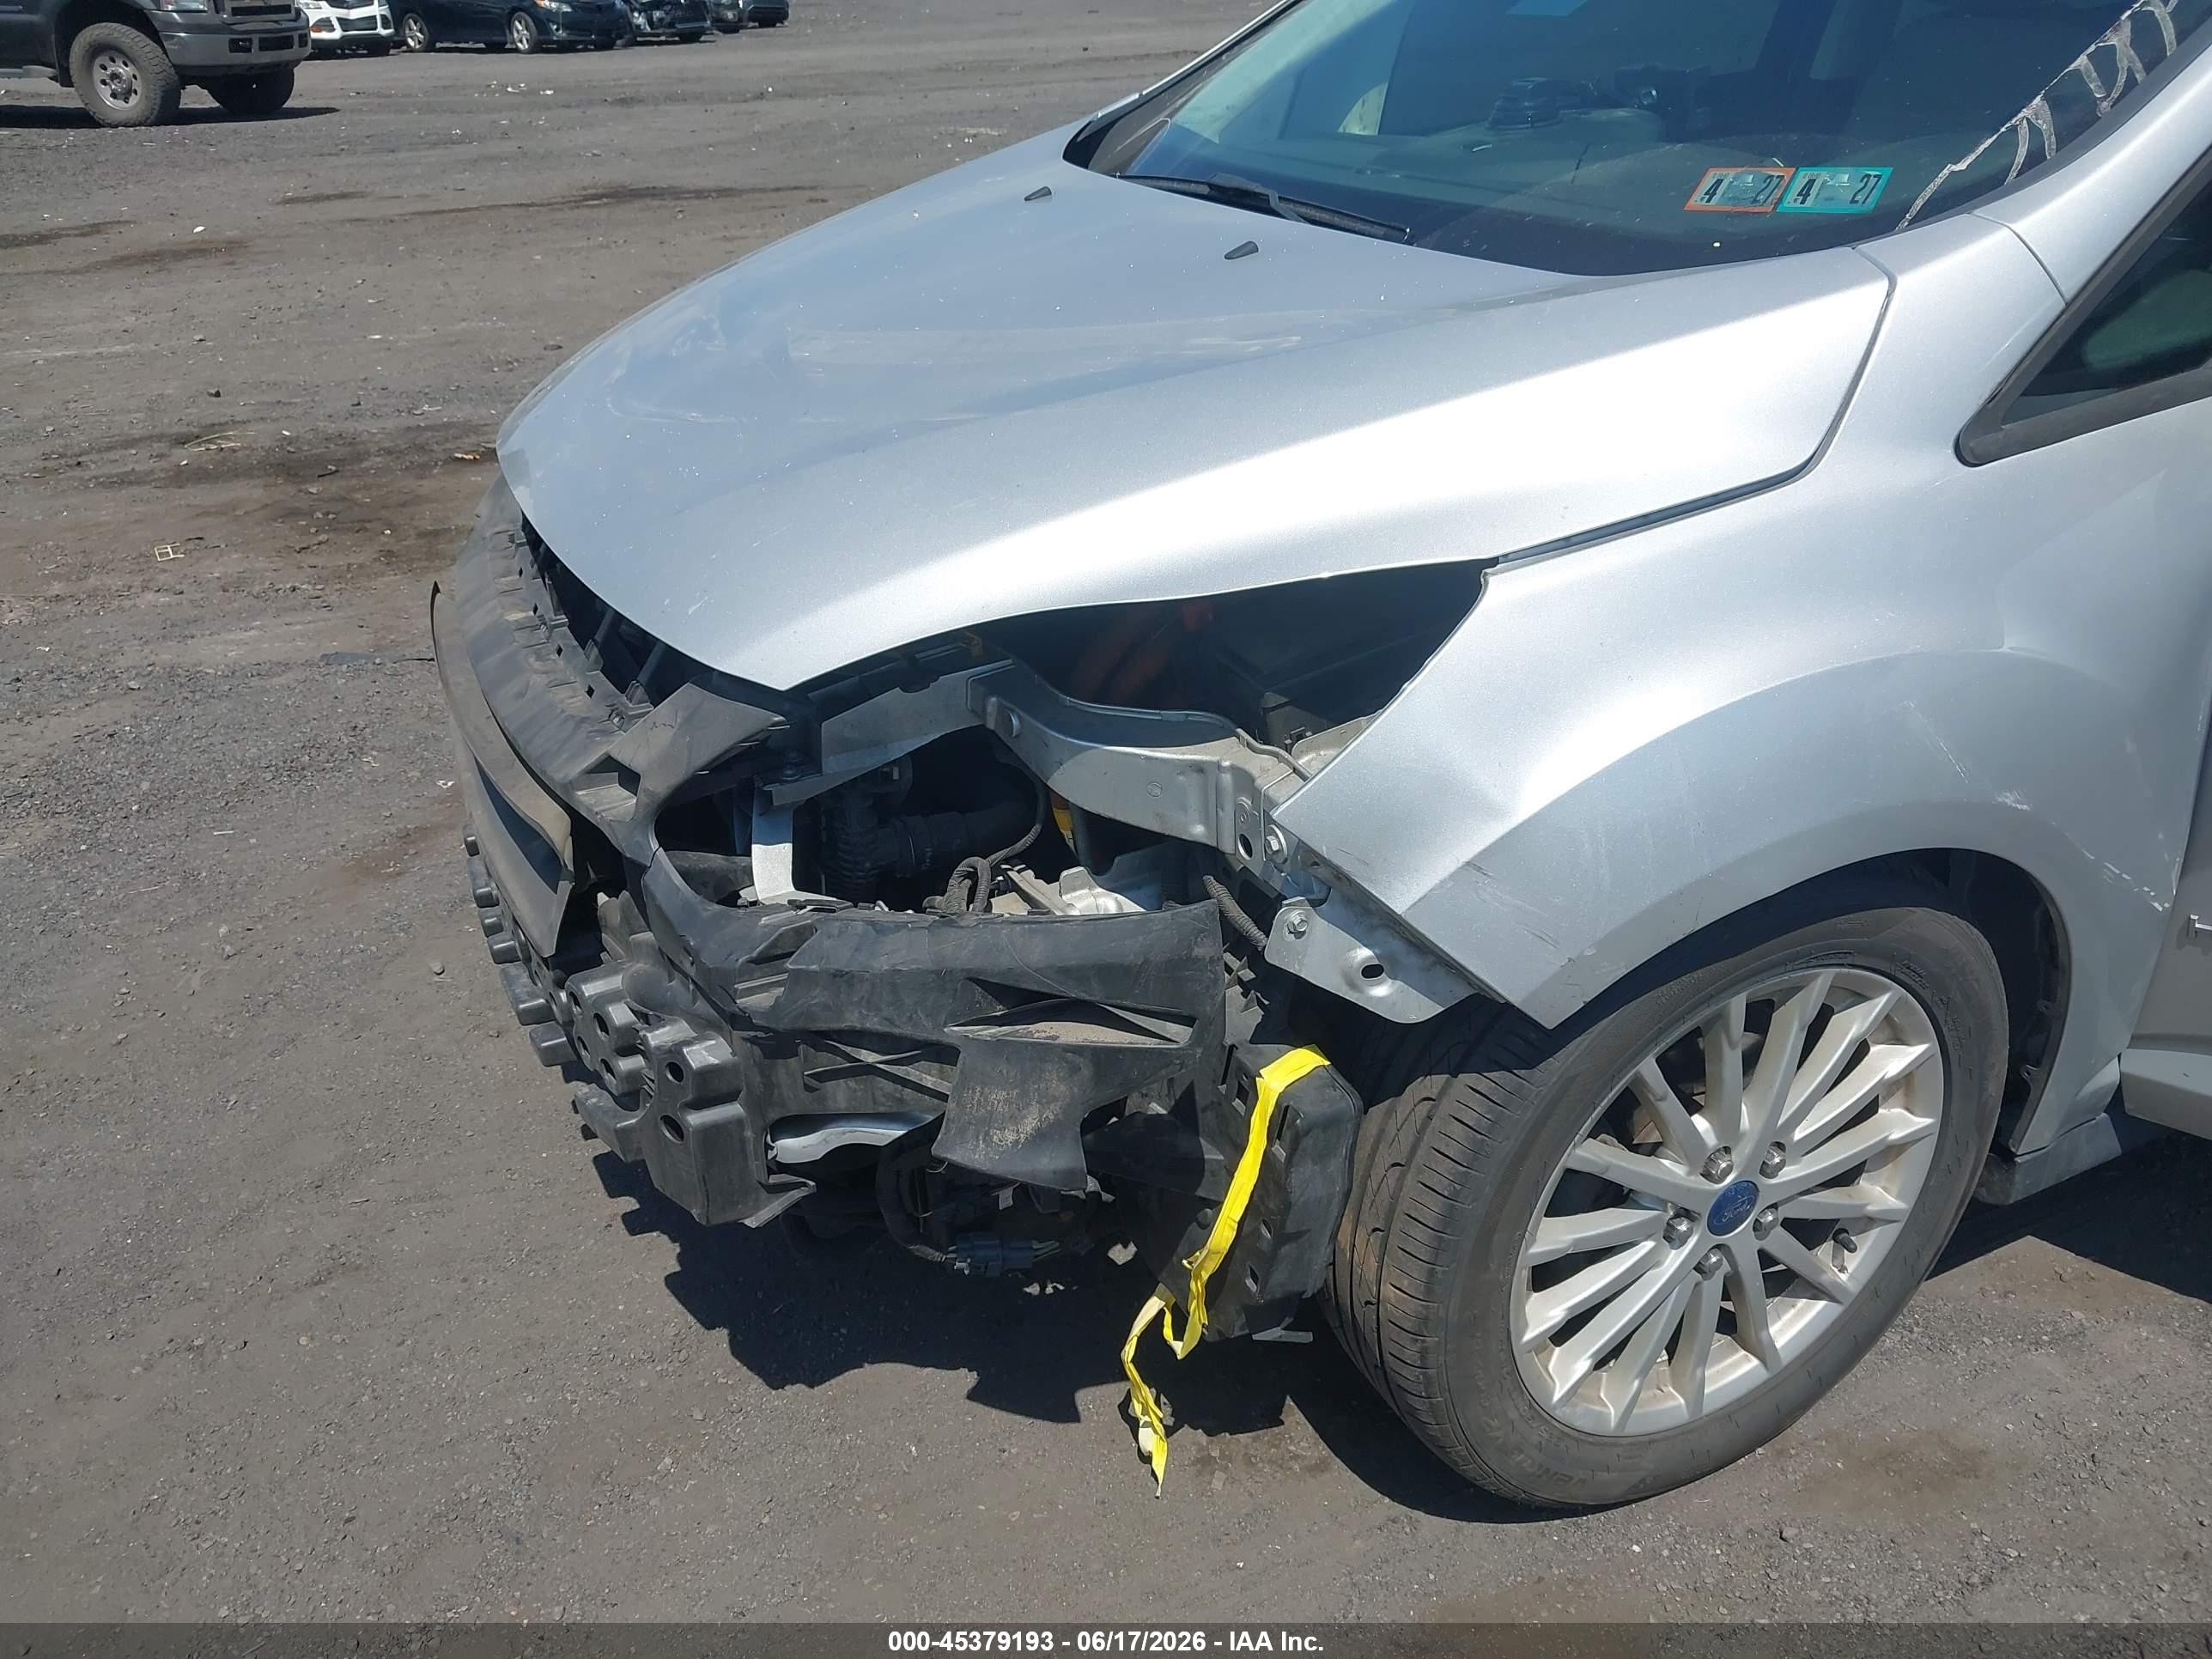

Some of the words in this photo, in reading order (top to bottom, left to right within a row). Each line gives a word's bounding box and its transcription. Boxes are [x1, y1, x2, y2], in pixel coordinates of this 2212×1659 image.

[1703, 178, 1724, 204] 4
[1796, 179, 1817, 205] 4
[1848, 173, 1883, 205] 27
